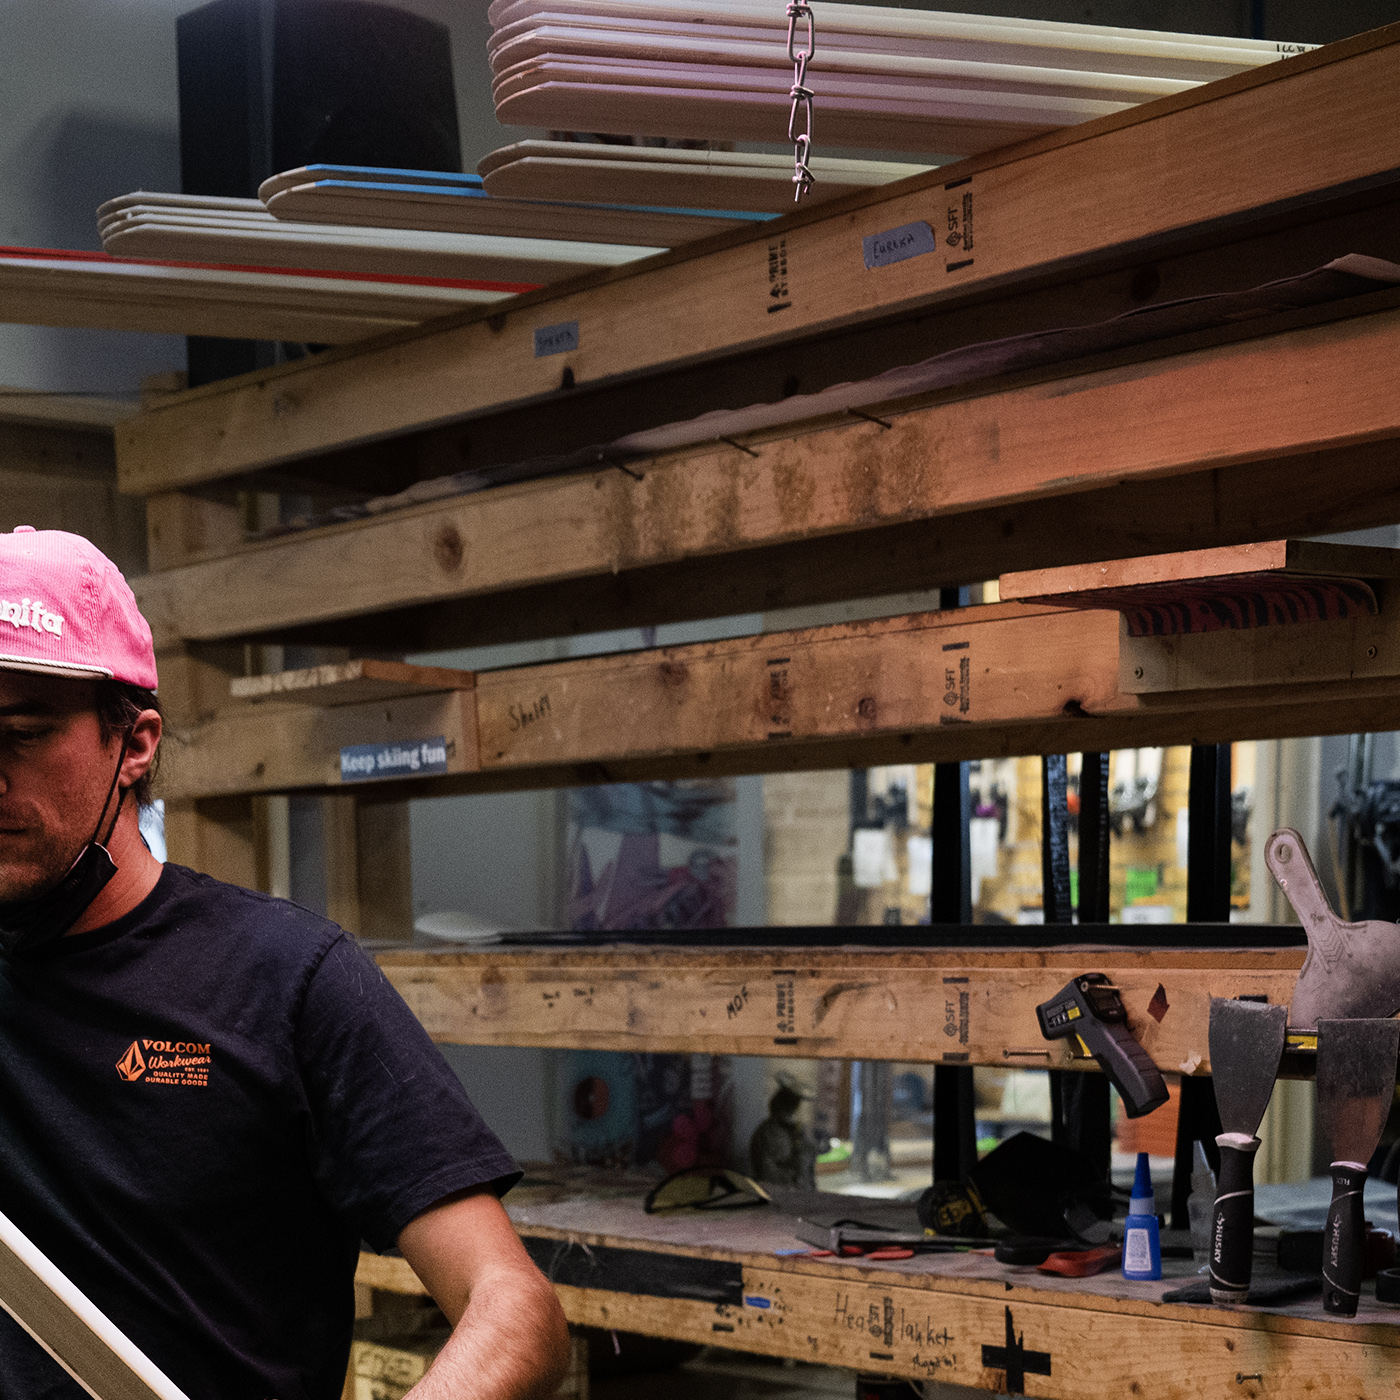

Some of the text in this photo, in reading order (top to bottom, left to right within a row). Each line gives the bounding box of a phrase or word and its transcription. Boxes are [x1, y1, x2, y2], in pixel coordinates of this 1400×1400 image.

[340, 743, 447, 774] Keep skiing fun
[726, 986, 750, 1020] MDF
[142, 1038, 212, 1055] VOLCOM
[148, 1054, 212, 1070] Workwear
[144, 1076, 209, 1087] DURABLE GOODS
[152, 1070, 209, 1081] QUALITY MADE
[1213, 1224, 1225, 1264] HUSKY
[1330, 1230, 1341, 1268] HUSKY
